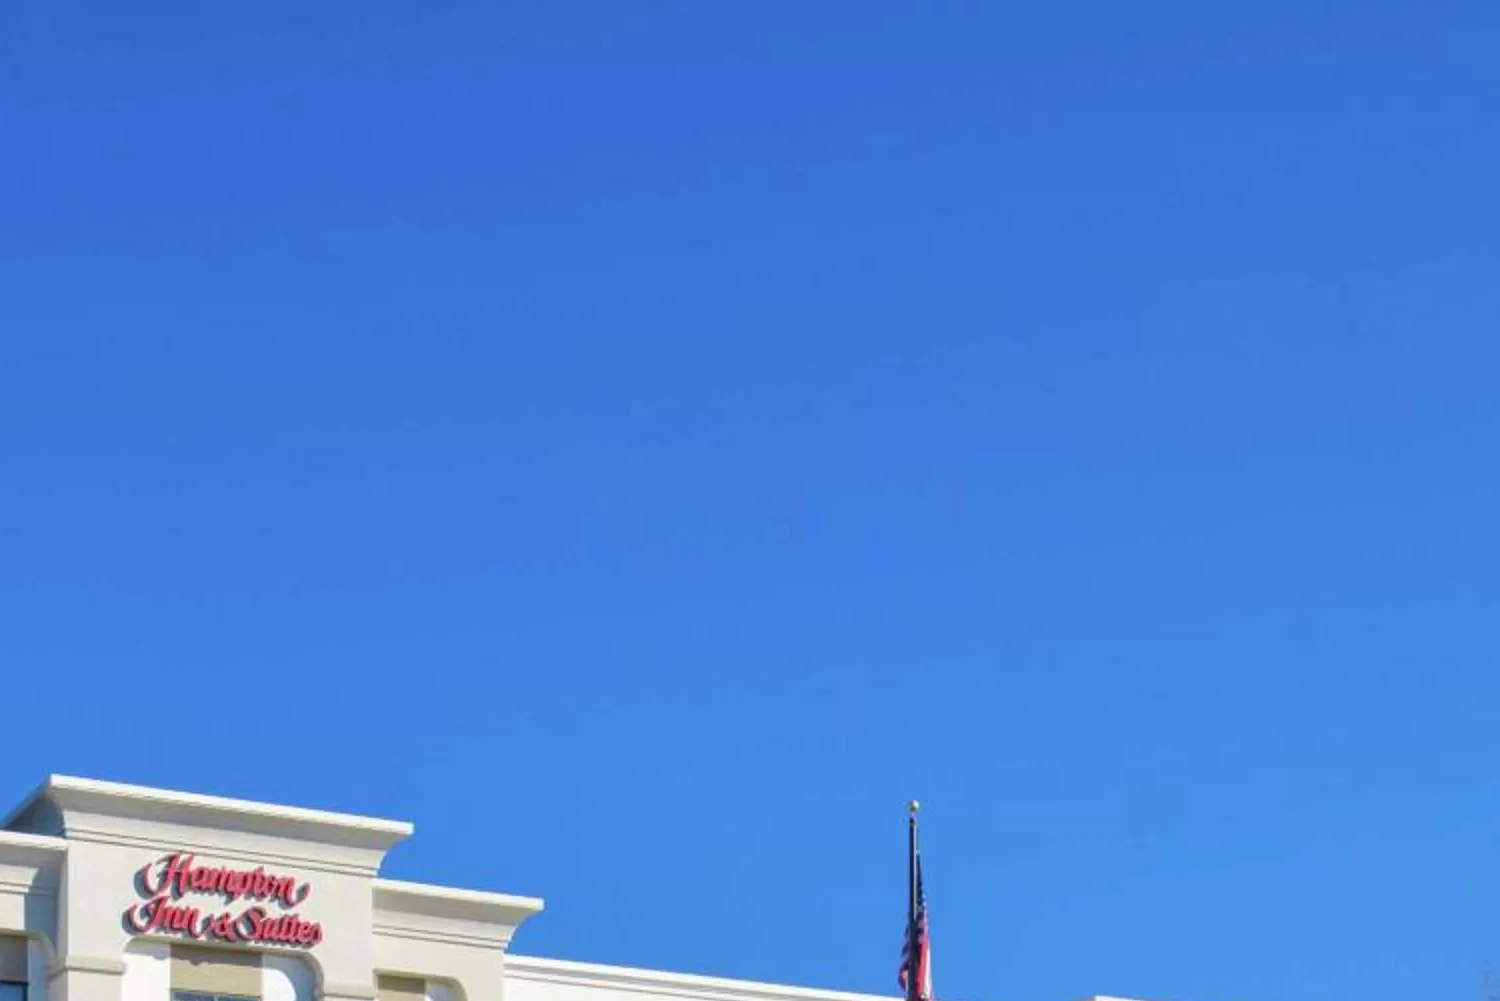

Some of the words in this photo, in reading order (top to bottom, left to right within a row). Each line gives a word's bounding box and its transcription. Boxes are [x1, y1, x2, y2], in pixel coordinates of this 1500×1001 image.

[135, 851, 311, 907] Hampton
[123, 895, 211, 938] Inn
[210, 911, 236, 942] &
[233, 906, 324, 948] Suites
